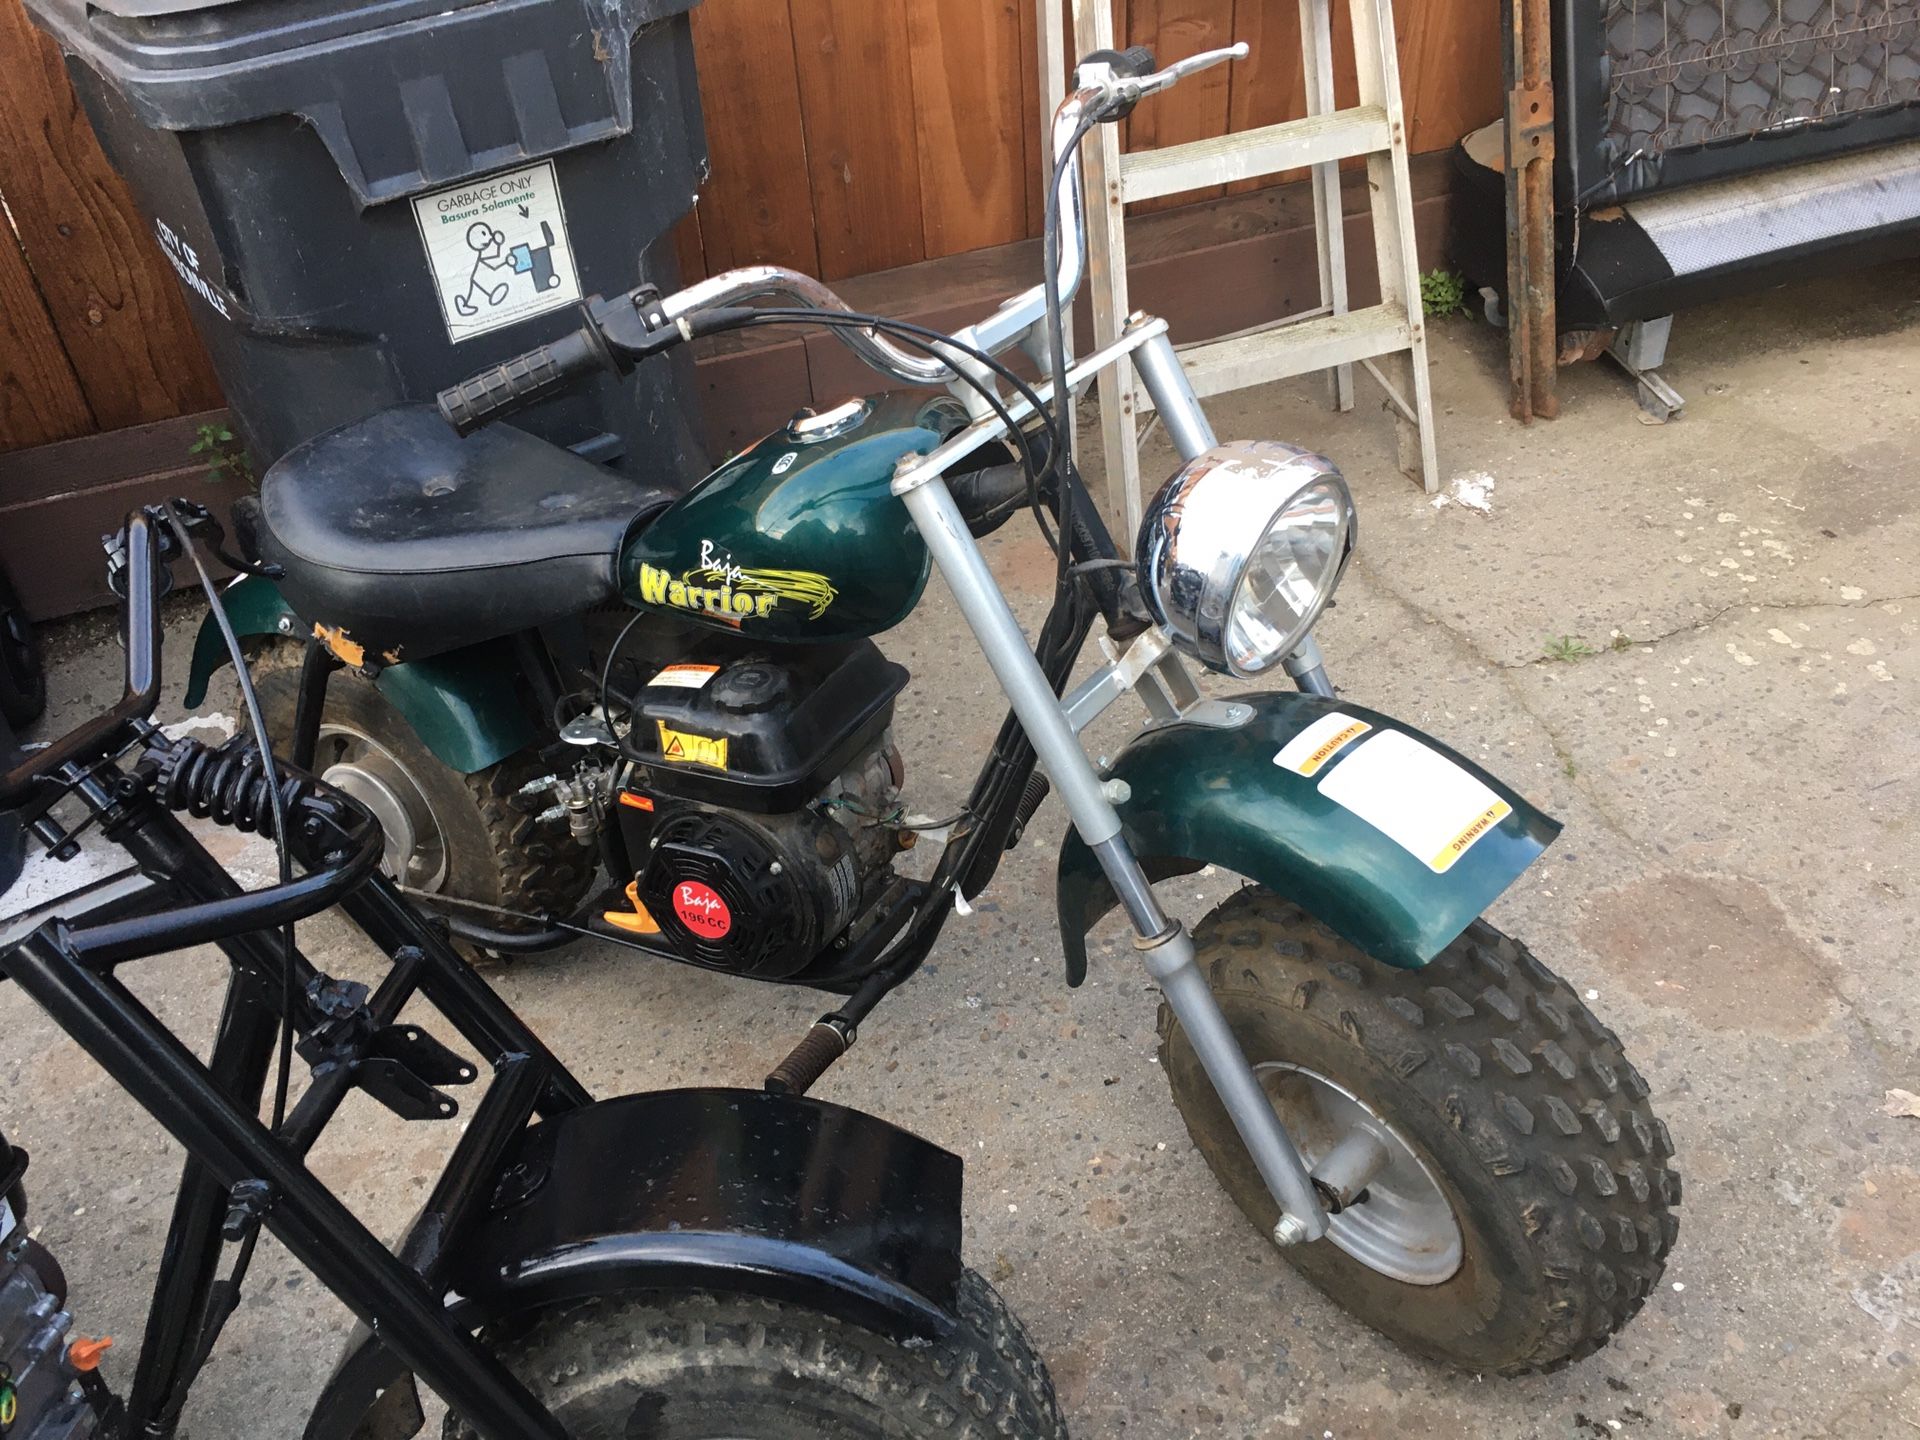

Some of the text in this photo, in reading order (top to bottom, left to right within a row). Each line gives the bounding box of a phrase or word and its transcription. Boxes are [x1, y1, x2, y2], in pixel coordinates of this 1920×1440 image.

[437, 175, 532, 212] GARBAGE ONLY
[441, 192, 536, 224] Basura Solamente
[701, 539, 760, 587] Baja
[639, 562, 778, 618] Warrior
[1312, 733, 1348, 762] CAUTION
[1452, 818, 1490, 852] WARNING
[681, 886, 721, 915] Baja
